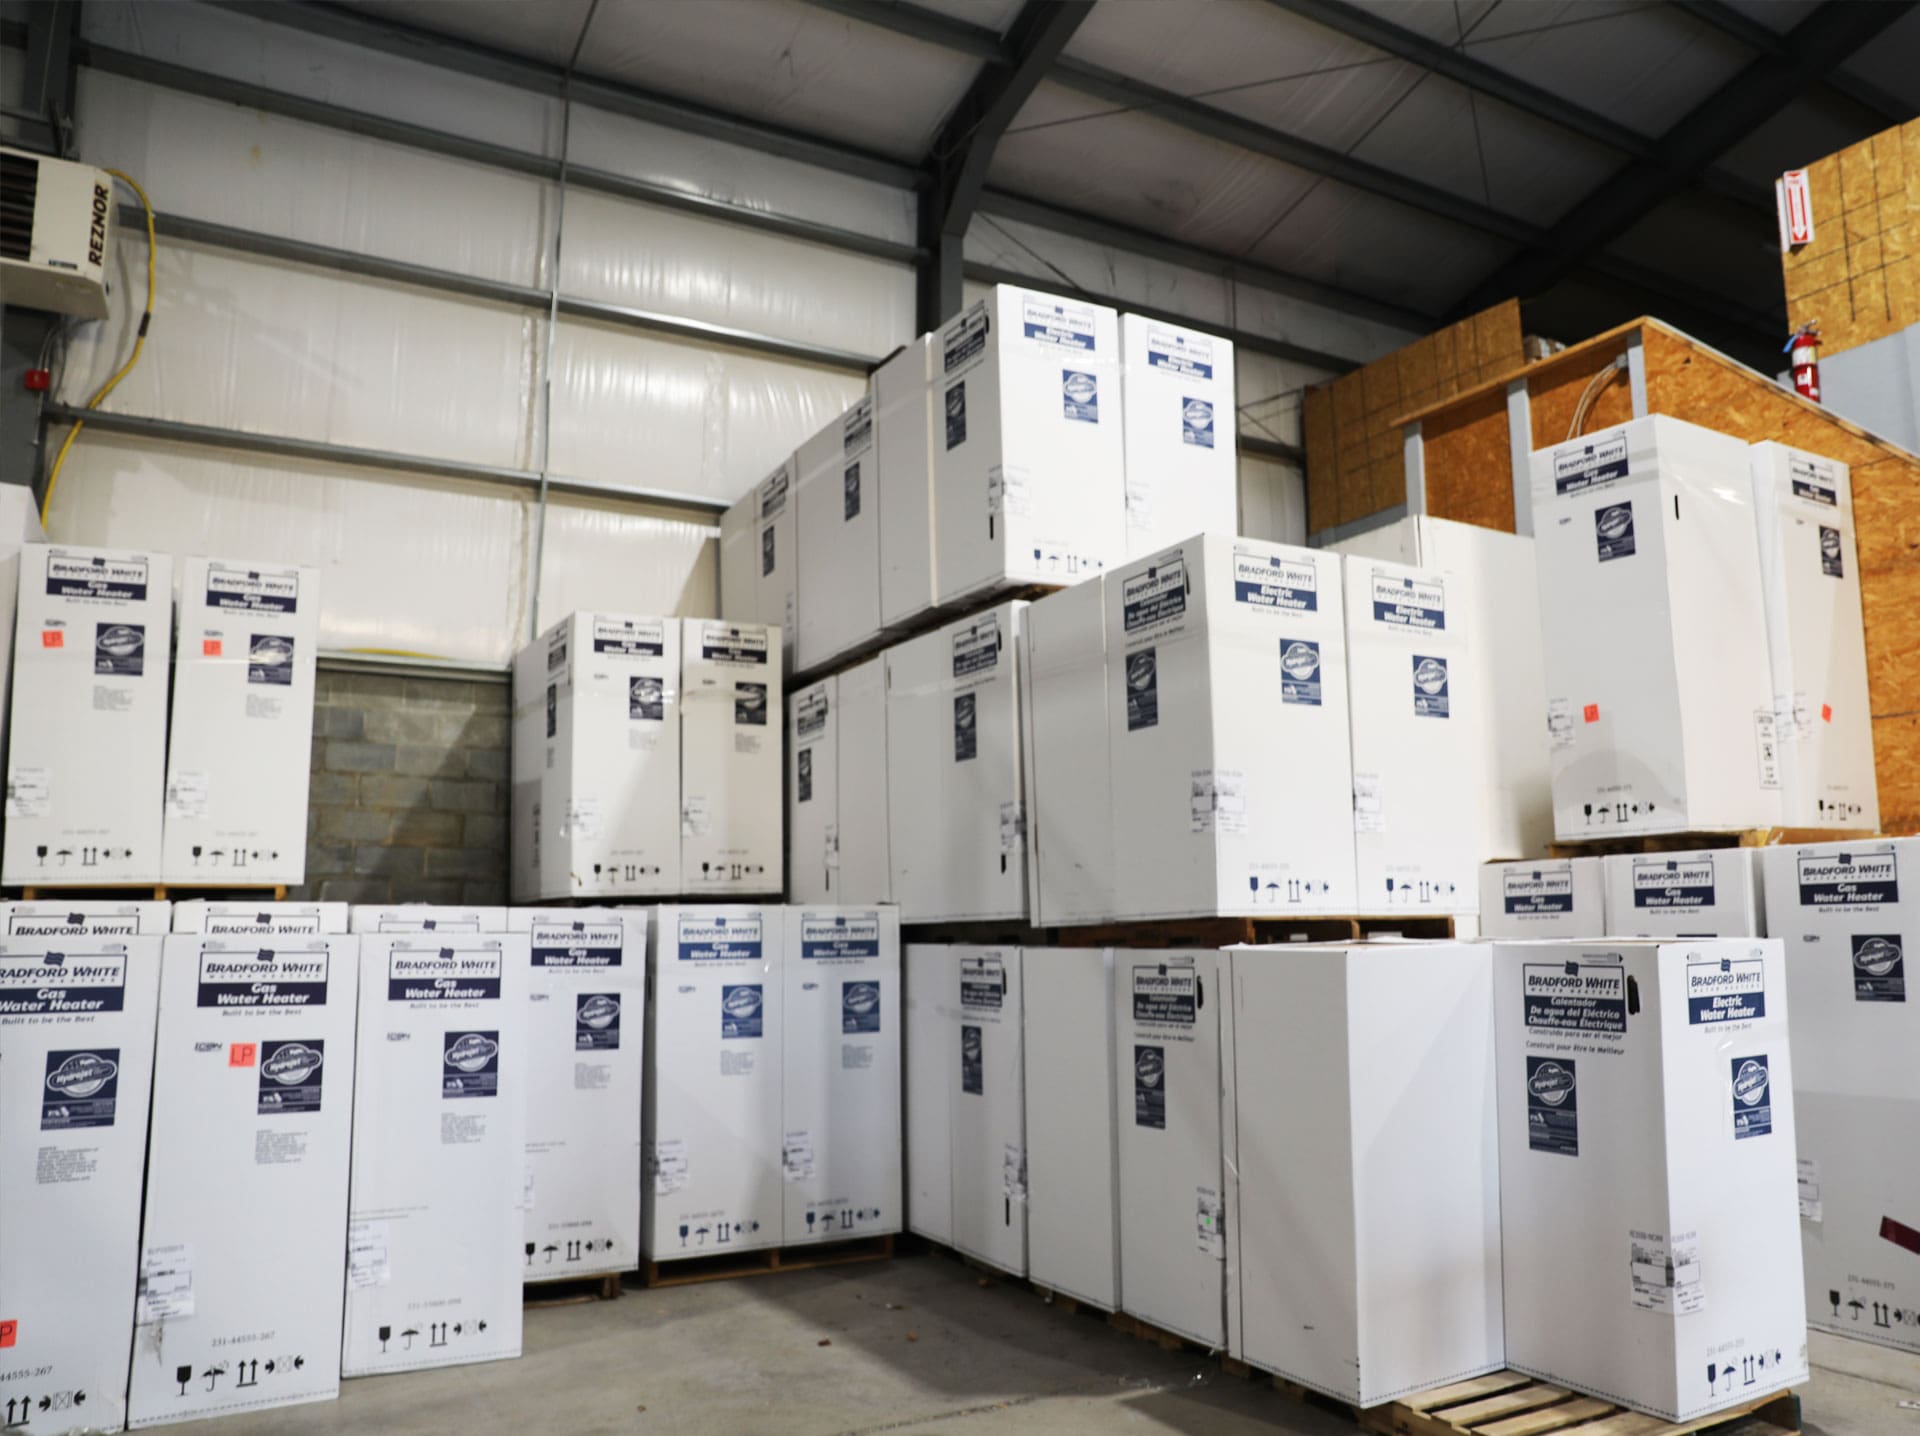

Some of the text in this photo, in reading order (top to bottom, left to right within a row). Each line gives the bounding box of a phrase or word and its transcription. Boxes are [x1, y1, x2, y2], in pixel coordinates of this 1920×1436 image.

[88, 184, 109, 266] REZNOR
[1238, 564, 1312, 583] BRADFORD WHITE
[1260, 585, 1293, 598] Electric
[1376, 585, 1415, 598] BRADFORD
[1248, 592, 1307, 609] Water Heater
[1637, 870, 1710, 881] BRADFORD WHITE
[1803, 864, 1892, 876] BRADFORD WHITE
[1507, 880, 1569, 890] BRADFORD WHITE
[1837, 883, 1857, 892] Gas
[1665, 888, 1681, 896] Gas
[1530, 896, 1544, 904] Gas
[1645, 896, 1703, 906] Water Heater
[1814, 893, 1884, 903] Water Heater
[1514, 903, 1563, 912] Water Heater
[16, 926, 133, 936] BRADFORD WHITE
[211, 926, 314, 934] BRADFORD WHITE
[682, 928, 728, 936] BRADFORD
[536, 932, 619, 941] BRADFORD WHITE
[568, 948, 587, 956] Gas
[690, 950, 750, 959] Water Heater
[395, 960, 497, 970] BRADFORD WHITE
[544, 955, 610, 965] Water Heater
[0, 966, 120, 978] RADFORD WHITE
[206, 962, 323, 973] BRADFORD WHITE
[434, 978, 458, 988] Gas
[1528, 975, 1620, 989] BRADFORD WHITE
[1691, 972, 1760, 987] BRADFORD WHITE
[37, 988, 66, 999] Gas
[251, 983, 278, 993] Gas
[405, 988, 486, 998] Water Heater
[217, 993, 310, 1005] Water Heater
[1551, 996, 1597, 1007] Calentador
[1712, 995, 1742, 1008] Electric
[0, 998, 104, 1012] Water Heater
[222, 1008, 302, 1017] Built to be the Best
[1530, 1006, 1620, 1019] De agua del Eléctrico
[1700, 1006, 1756, 1022] Water Heater
[2, 1015, 95, 1026] Built to be the Best
[1528, 1016, 1577, 1027] Chauffe-eau
[1602, 1032, 1622, 1041] mejor
[232, 1048, 252, 1064] LP
[1, 1325, 12, 1336] P
